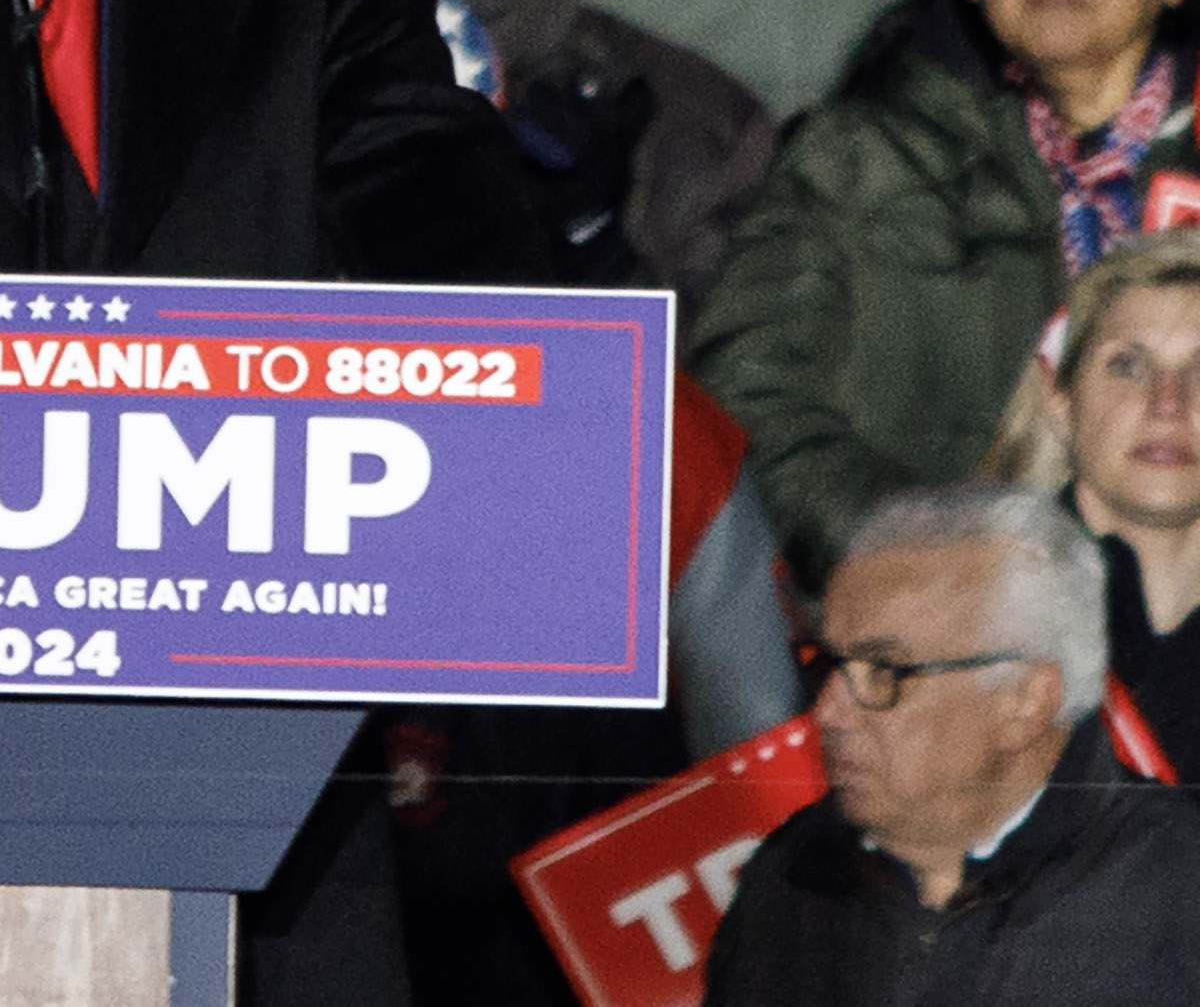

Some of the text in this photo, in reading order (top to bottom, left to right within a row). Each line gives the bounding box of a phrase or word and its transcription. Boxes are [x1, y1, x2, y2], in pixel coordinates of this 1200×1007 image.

[225, 345, 309, 393] TO
[325, 347, 516, 398] 88022
[53, 576, 209, 612] GREAT
[220, 580, 388, 616] AGAIN!
